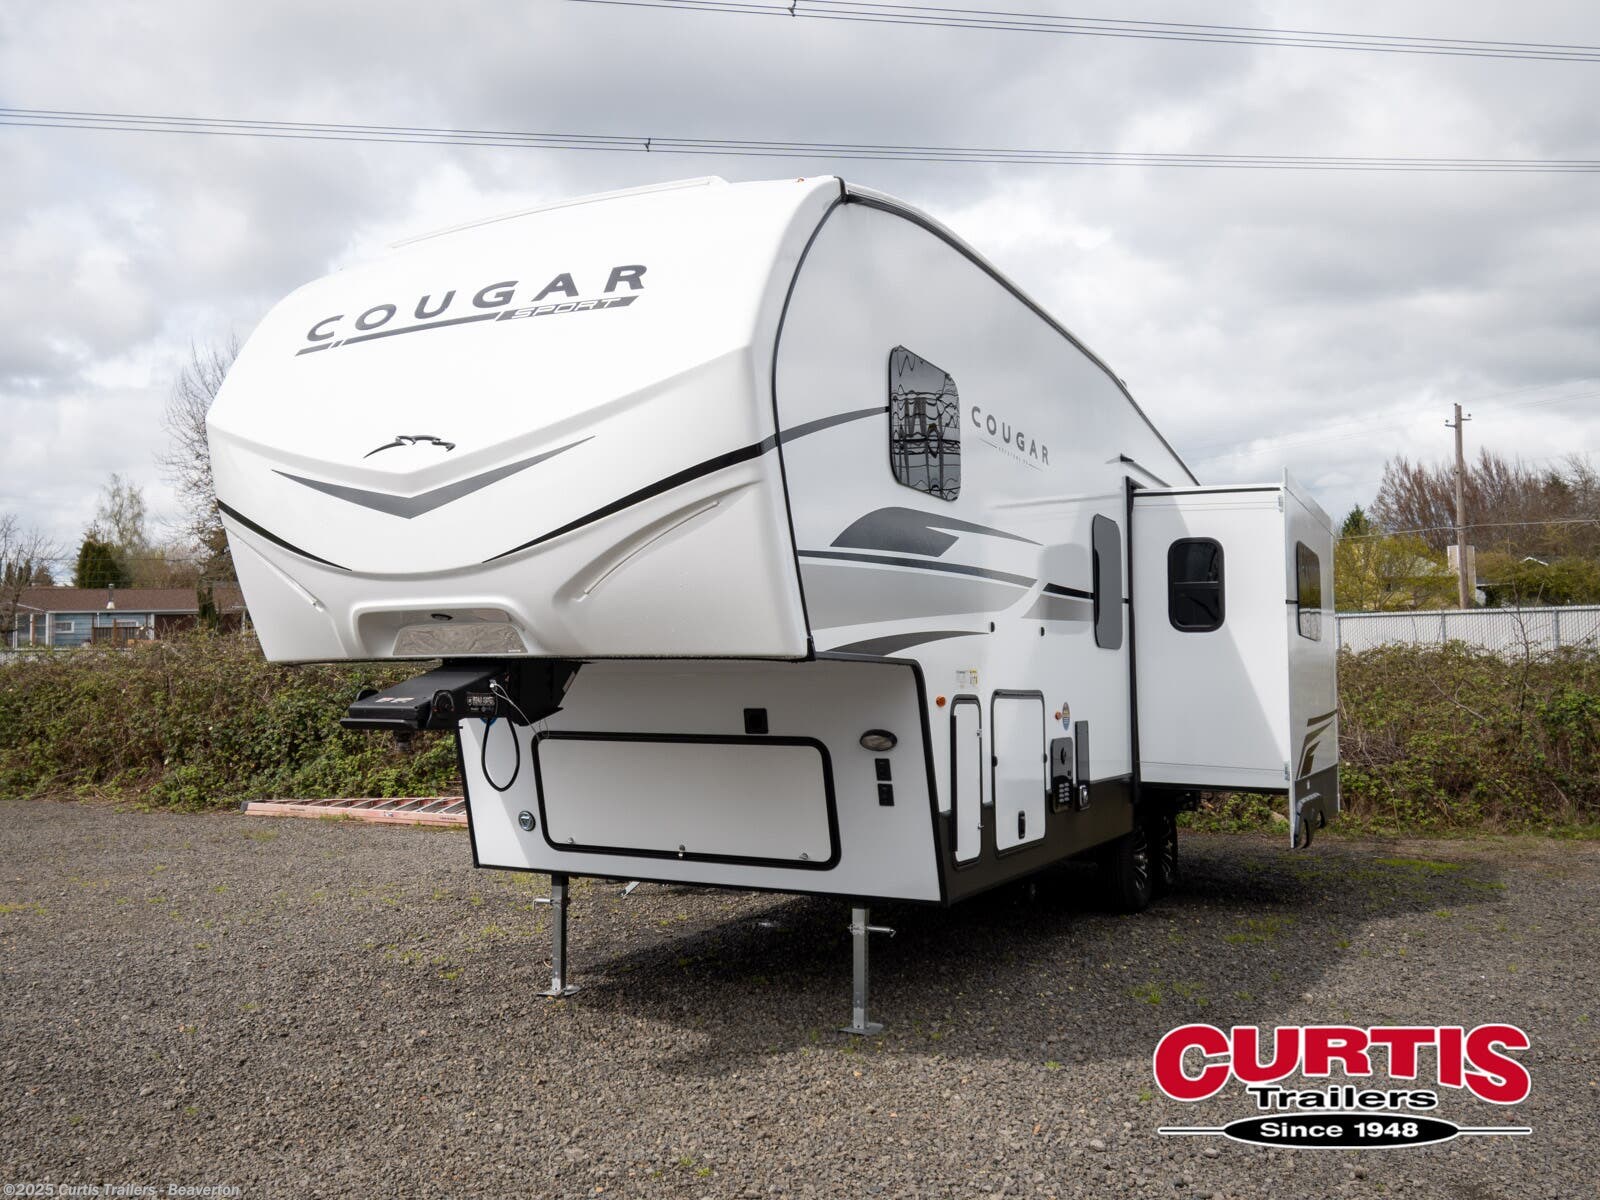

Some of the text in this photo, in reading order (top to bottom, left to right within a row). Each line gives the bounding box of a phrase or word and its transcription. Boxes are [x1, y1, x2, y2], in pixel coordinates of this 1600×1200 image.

[306, 264, 647, 342] COUGAR
[511, 296, 622, 319] SPORT
[971, 405, 1050, 466] COUGAR
